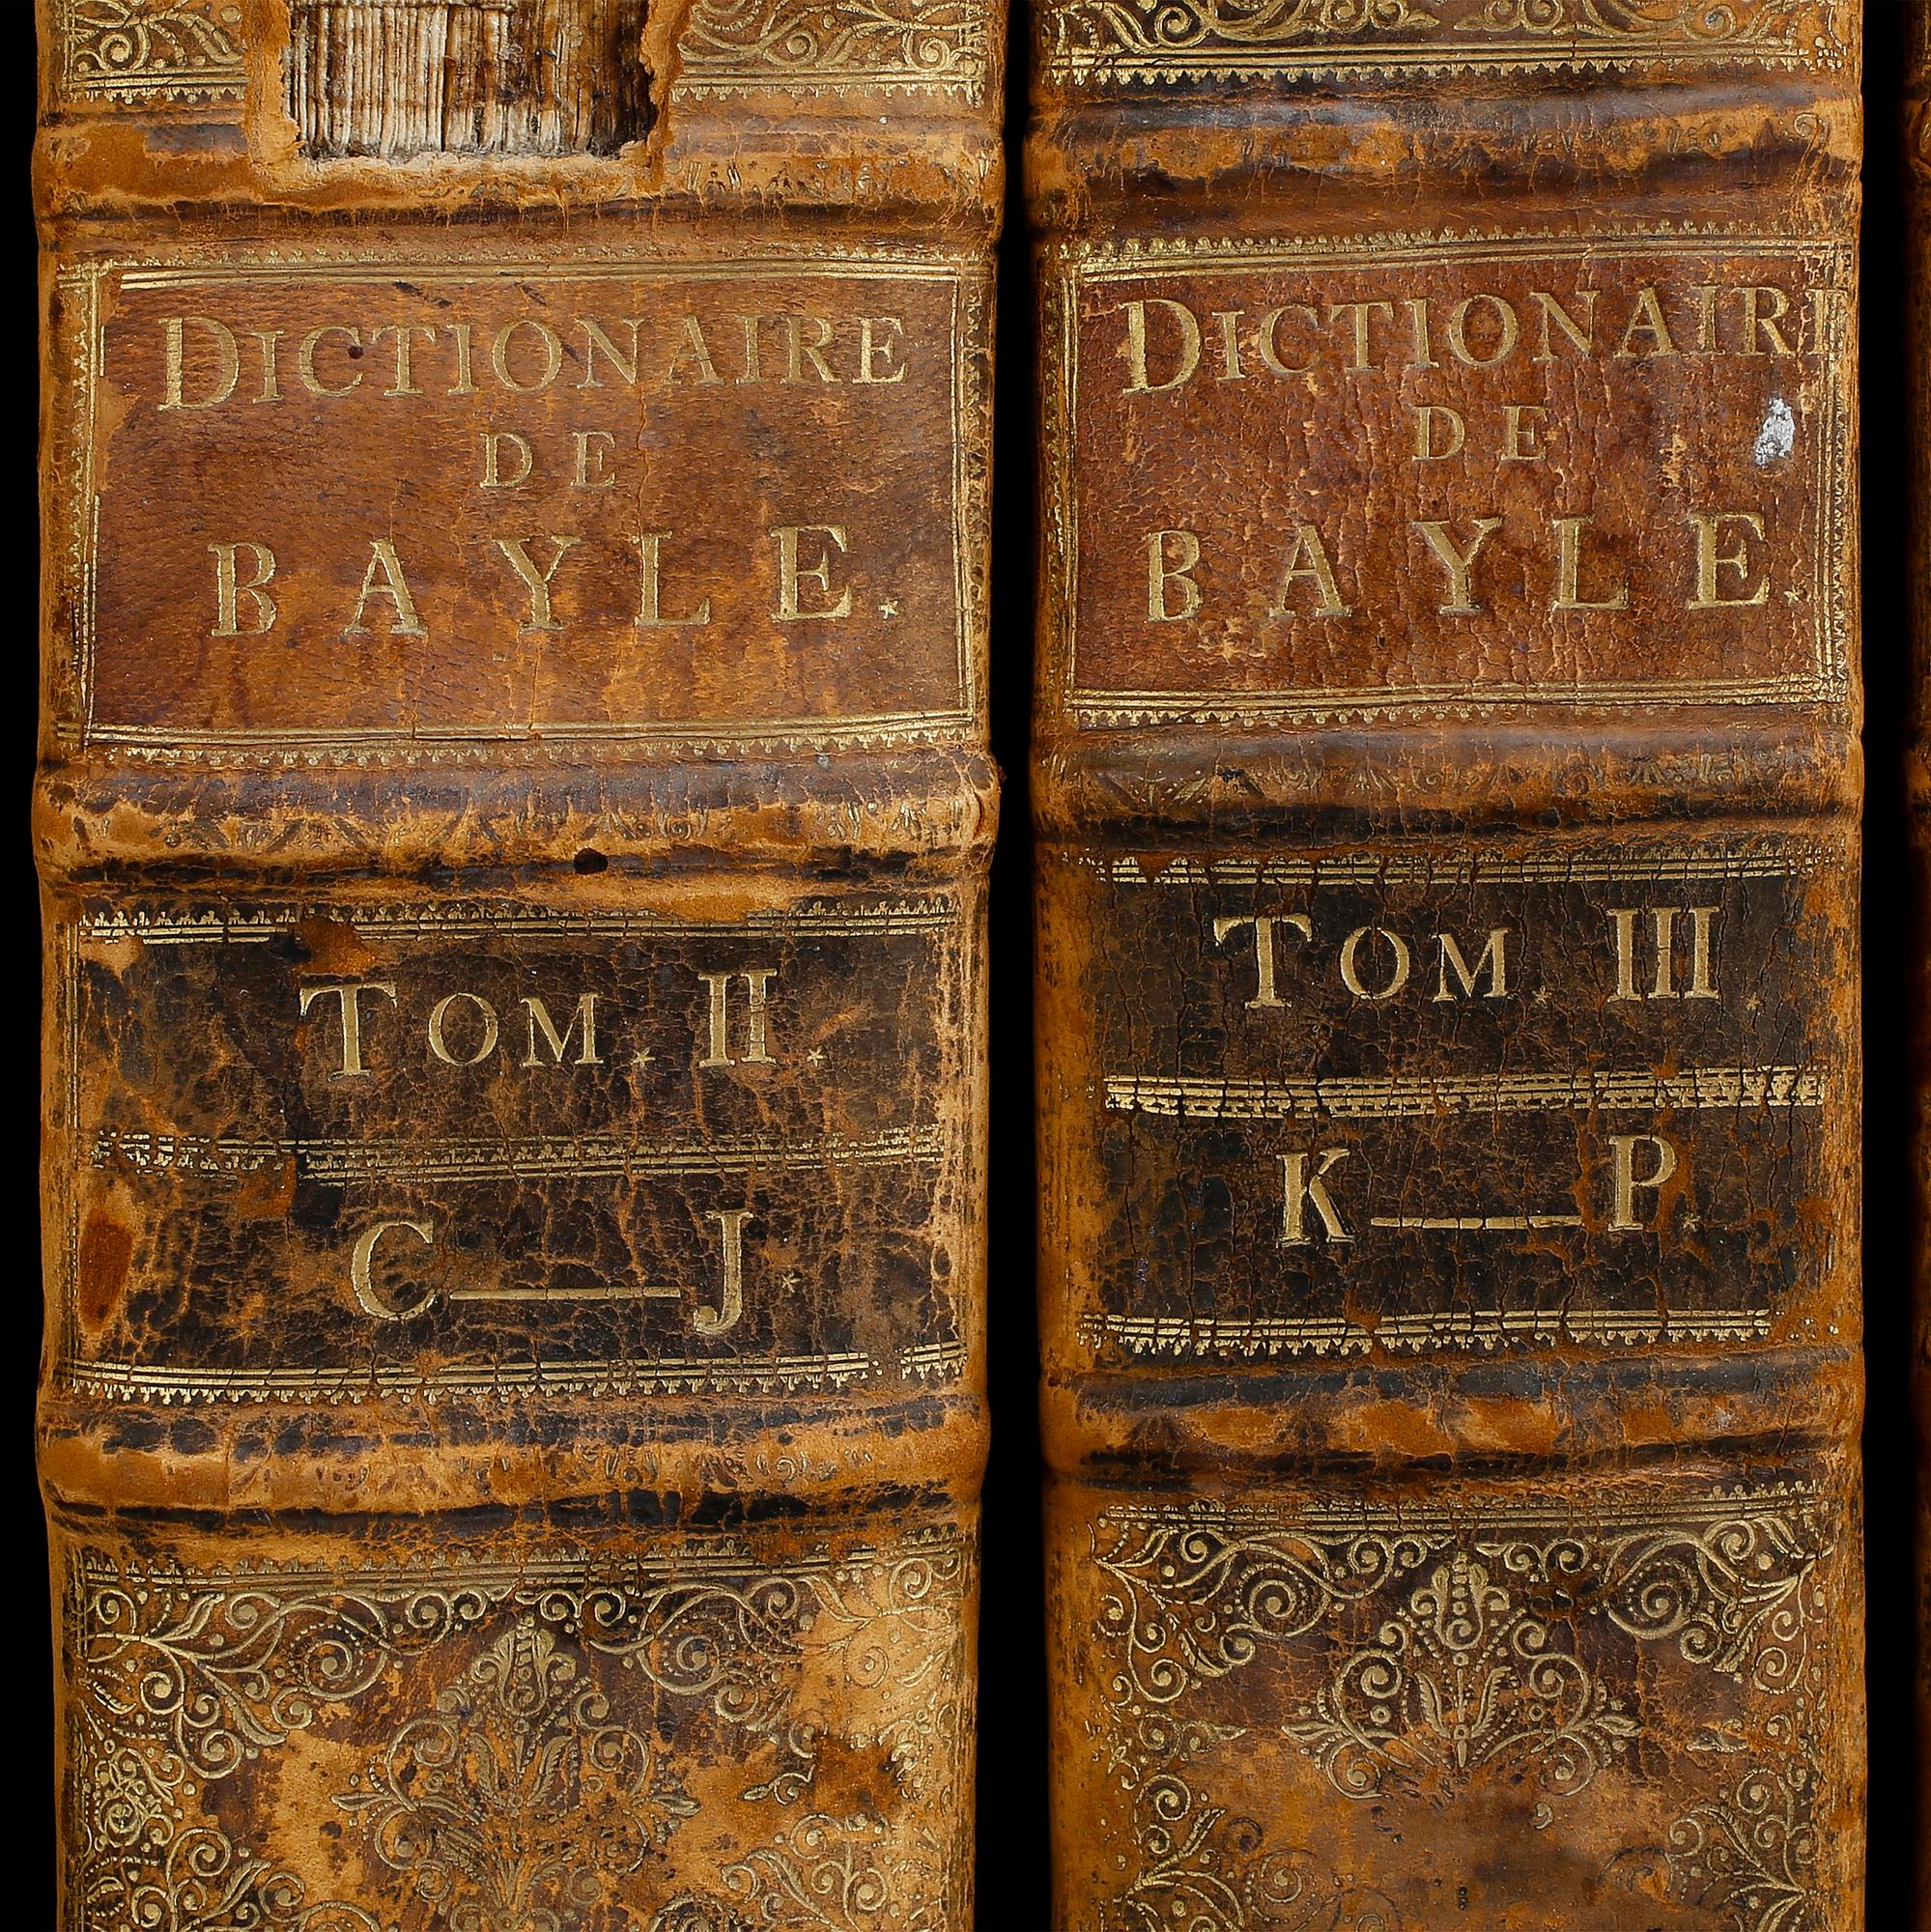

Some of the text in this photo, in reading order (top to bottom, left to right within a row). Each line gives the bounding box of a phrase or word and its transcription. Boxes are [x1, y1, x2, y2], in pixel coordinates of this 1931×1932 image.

[157, 315, 909, 412] DICTIONAIRE
[477, 431, 618, 489] DE
[1410, 404, 1548, 463] DE
